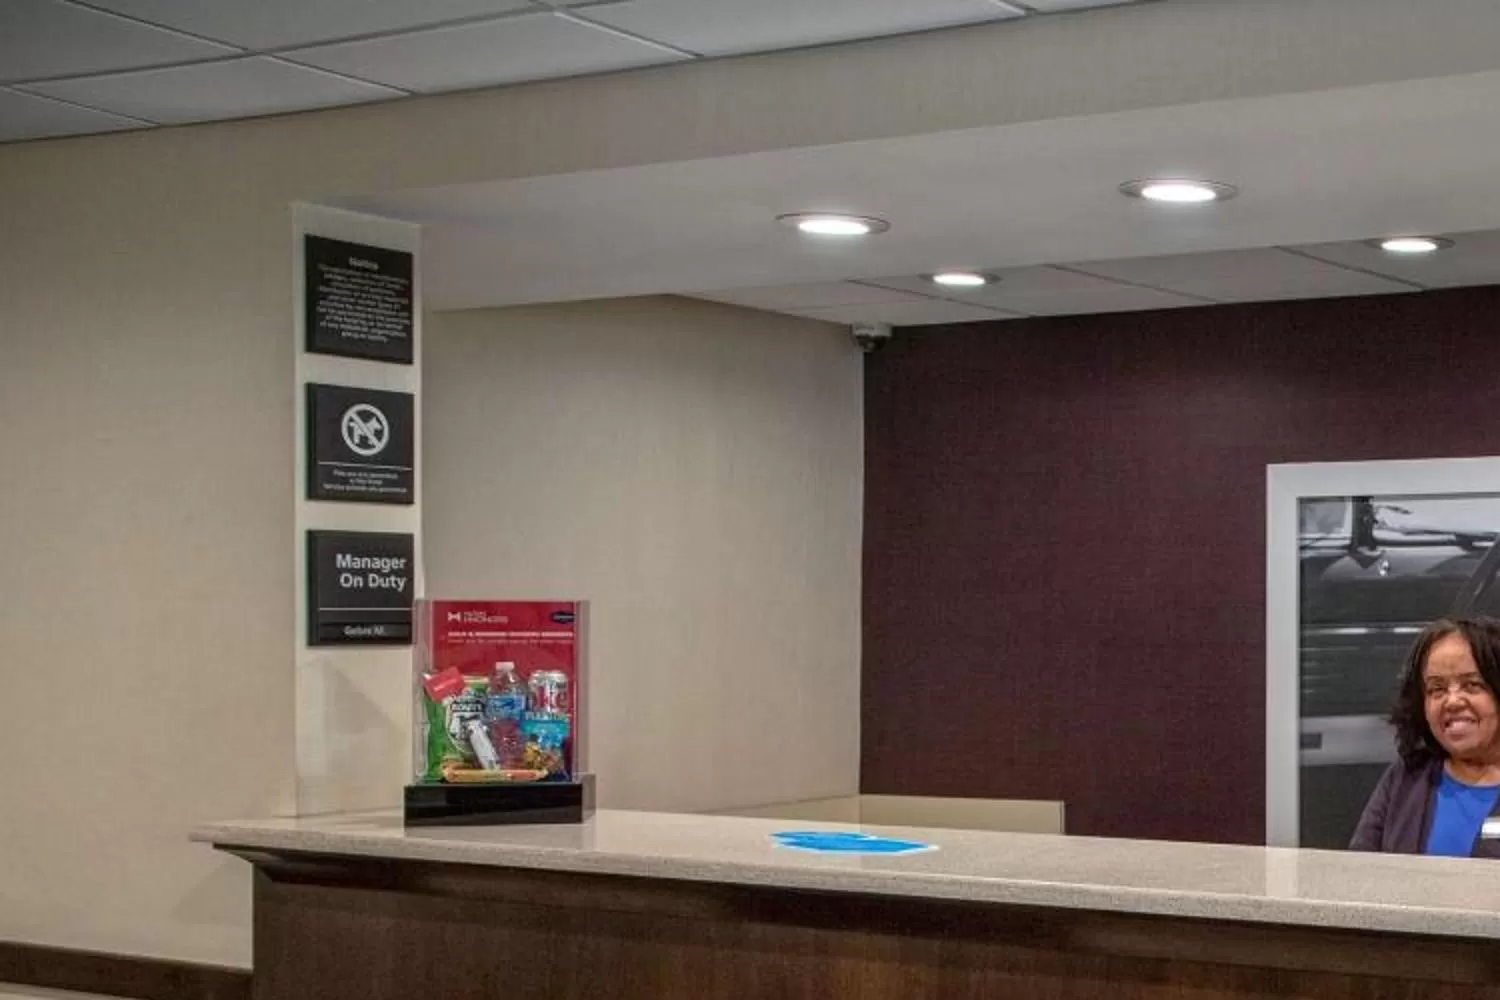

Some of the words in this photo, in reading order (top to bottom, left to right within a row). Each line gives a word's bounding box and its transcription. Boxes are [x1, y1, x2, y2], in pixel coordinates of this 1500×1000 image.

[336, 553, 407, 573] Manager
[340, 573, 364, 588] On
[367, 573, 407, 592] Duty
